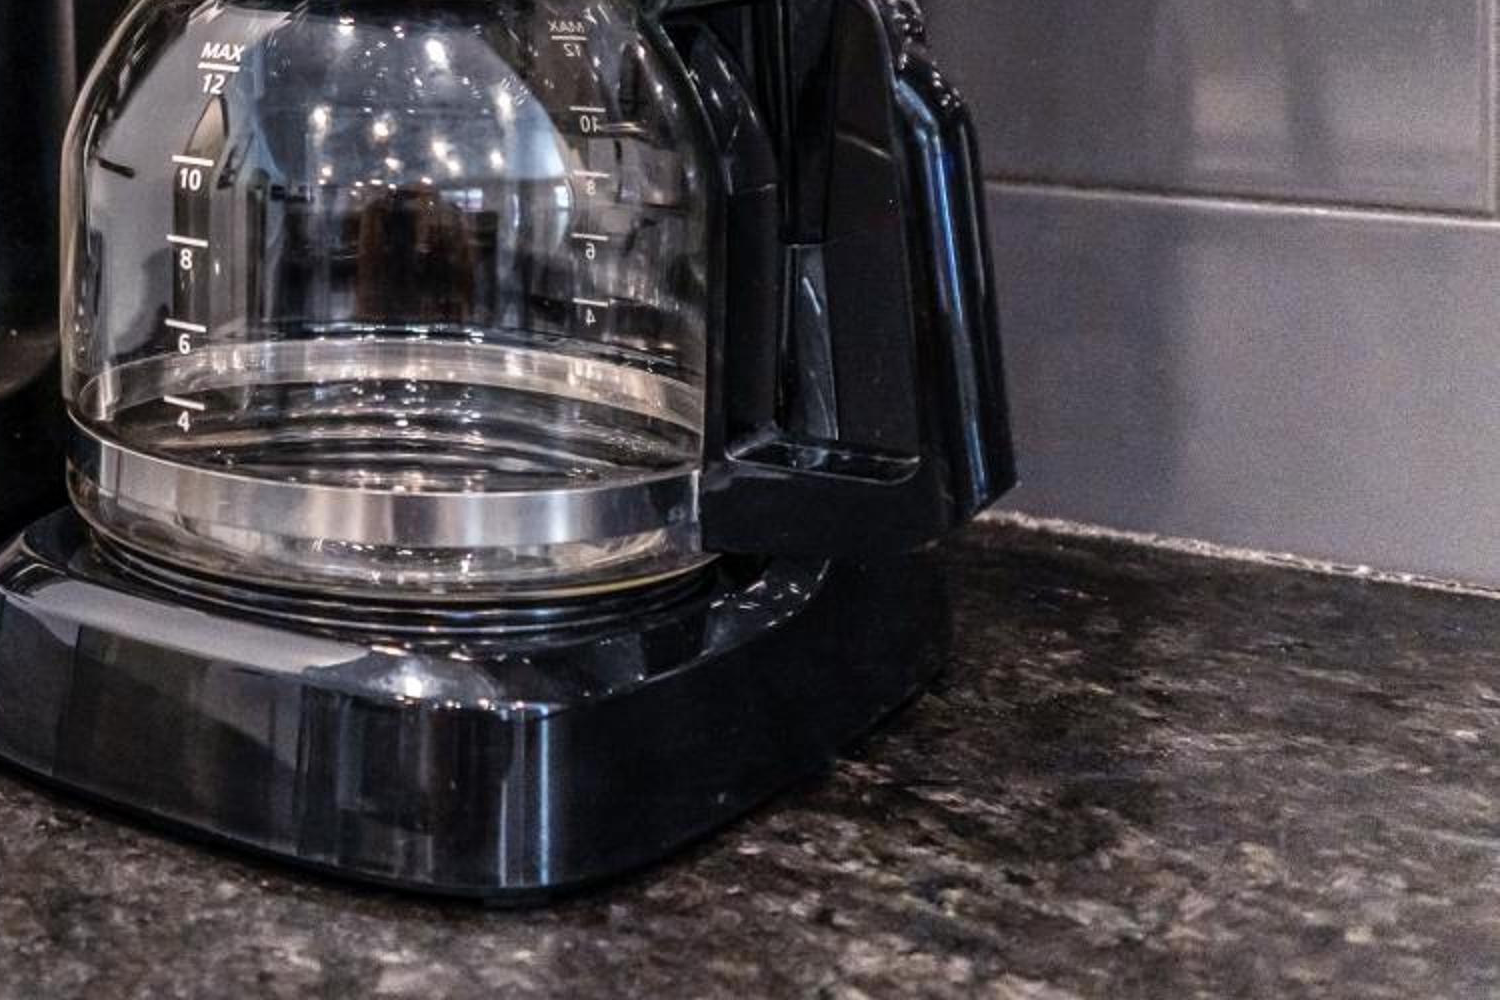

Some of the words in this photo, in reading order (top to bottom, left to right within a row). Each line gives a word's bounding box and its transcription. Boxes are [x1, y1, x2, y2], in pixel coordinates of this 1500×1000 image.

[201, 41, 245, 62] MAX
[202, 73, 225, 95] 12
[180, 167, 202, 191] 10
[179, 248, 193, 271] 8
[178, 333, 191, 355] 6
[177, 410, 190, 432] 4
